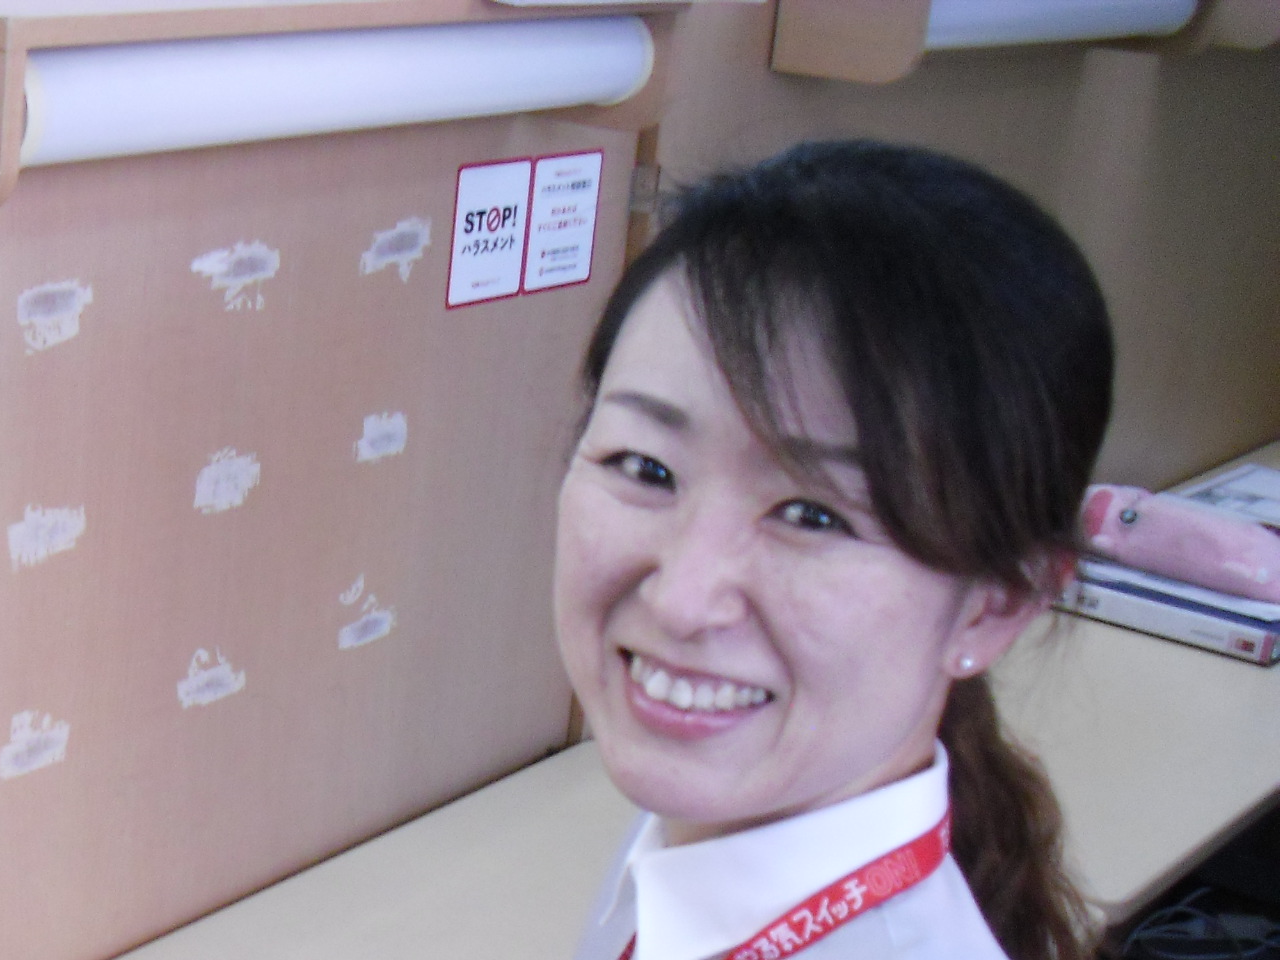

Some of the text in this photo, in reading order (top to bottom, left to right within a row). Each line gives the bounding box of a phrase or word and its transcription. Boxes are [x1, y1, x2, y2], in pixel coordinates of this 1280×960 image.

[464, 205, 518, 234] STOP!
[462, 234, 516, 257] ハラスメント
